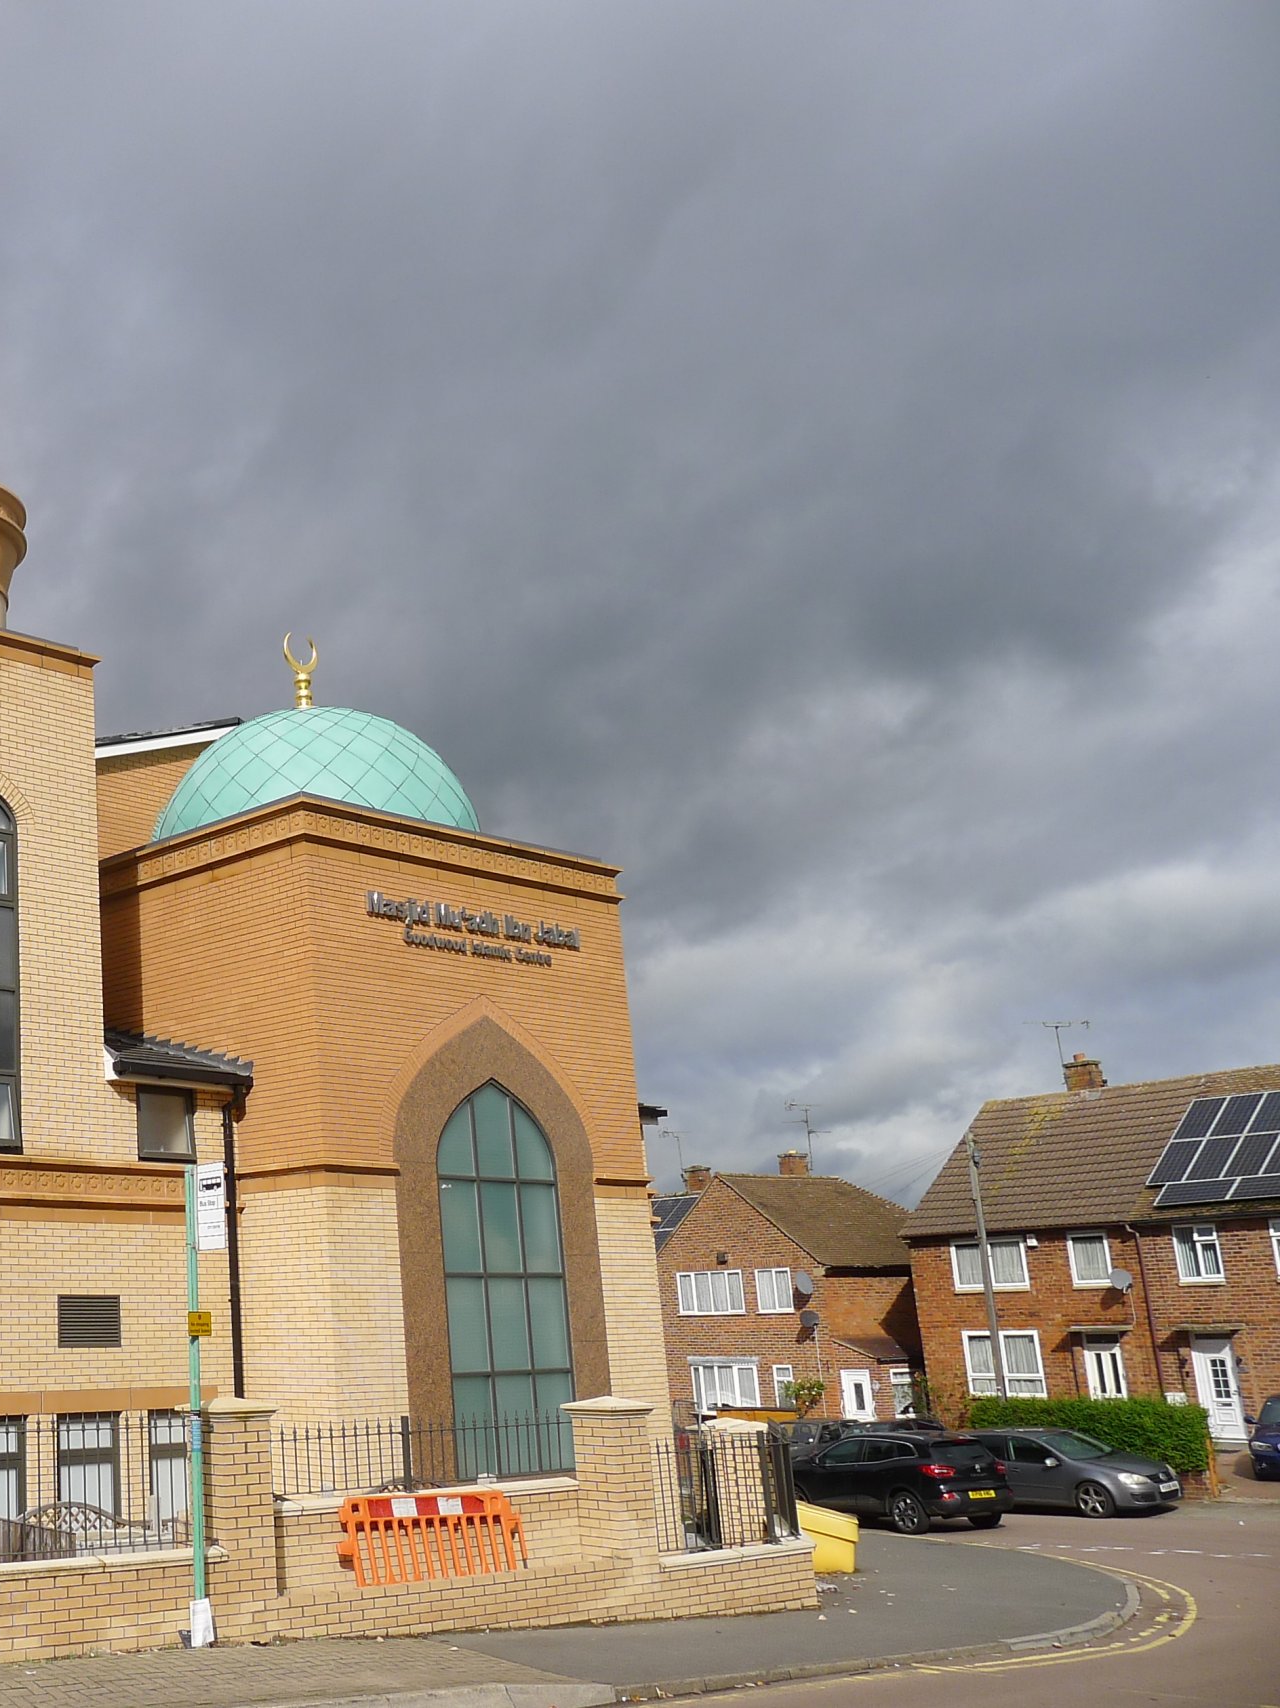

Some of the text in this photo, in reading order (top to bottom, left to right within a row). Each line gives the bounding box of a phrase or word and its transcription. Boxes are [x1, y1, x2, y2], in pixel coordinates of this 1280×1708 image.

[366, 890, 431, 929] Masjid
[503, 914, 531, 940] Ibn
[534, 920, 580, 949] Jabal
[403, 928, 553, 966] Goodwood Islamic Centre
